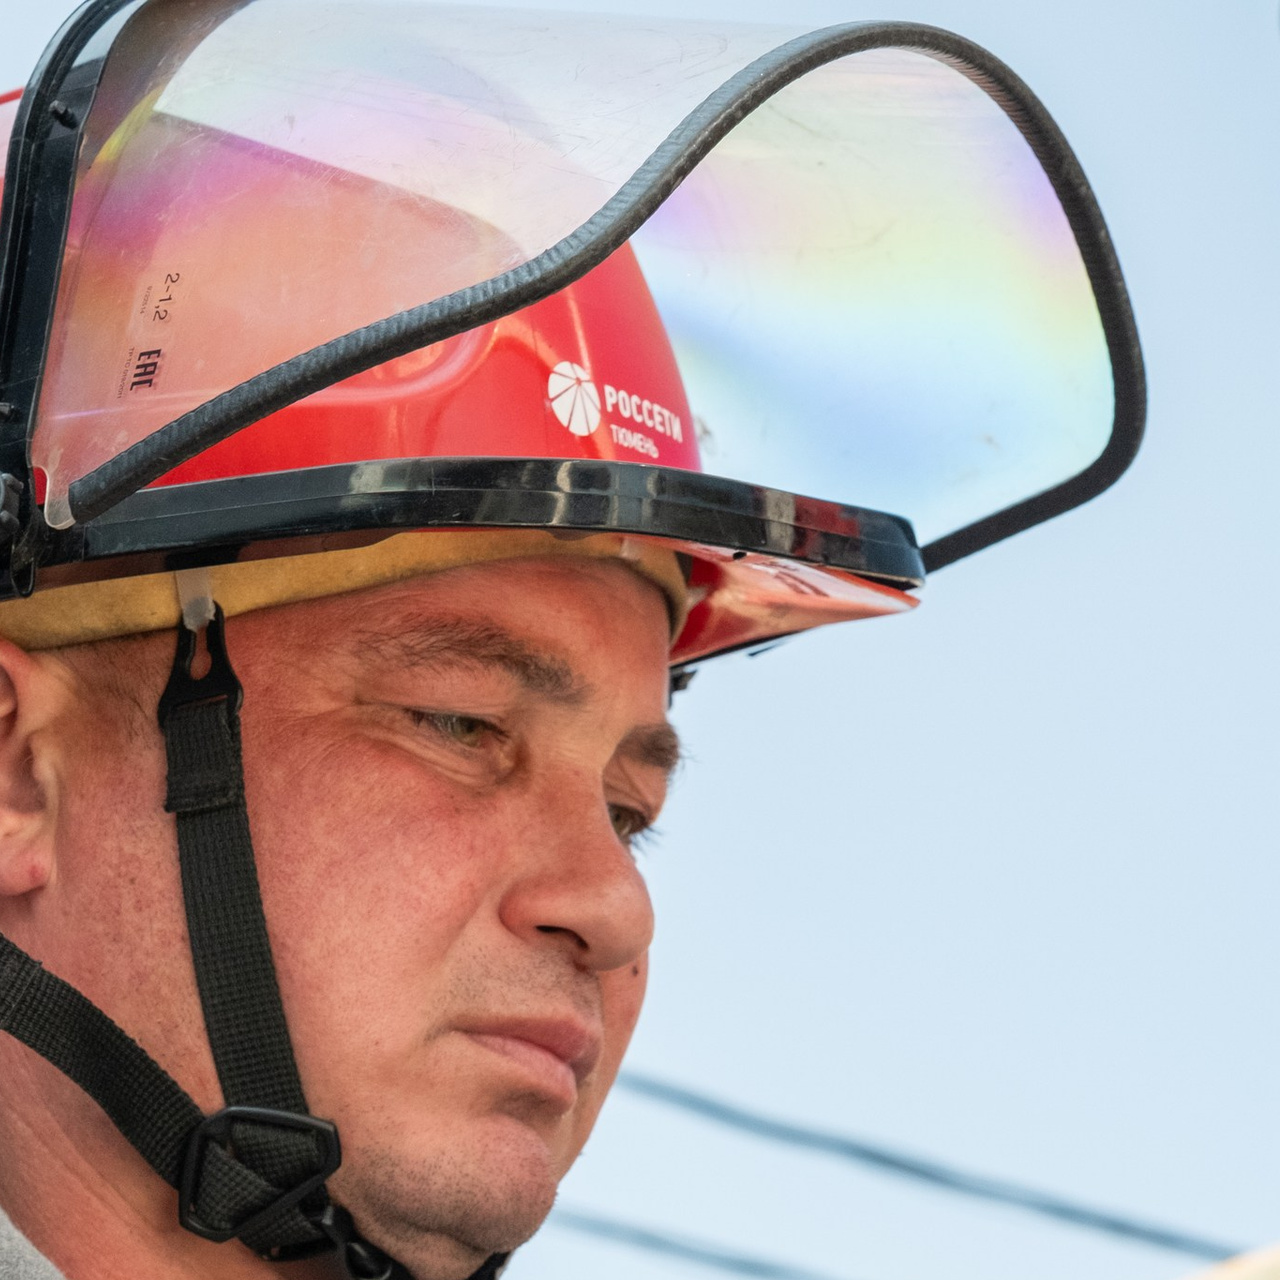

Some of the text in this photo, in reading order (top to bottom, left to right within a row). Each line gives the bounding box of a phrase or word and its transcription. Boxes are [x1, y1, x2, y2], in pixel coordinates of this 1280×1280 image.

[153, 272, 181, 322] 2-1,2
[603, 384, 684, 444] РОССЕТИ
[609, 423, 660, 459] ТЮМЕНЬ
